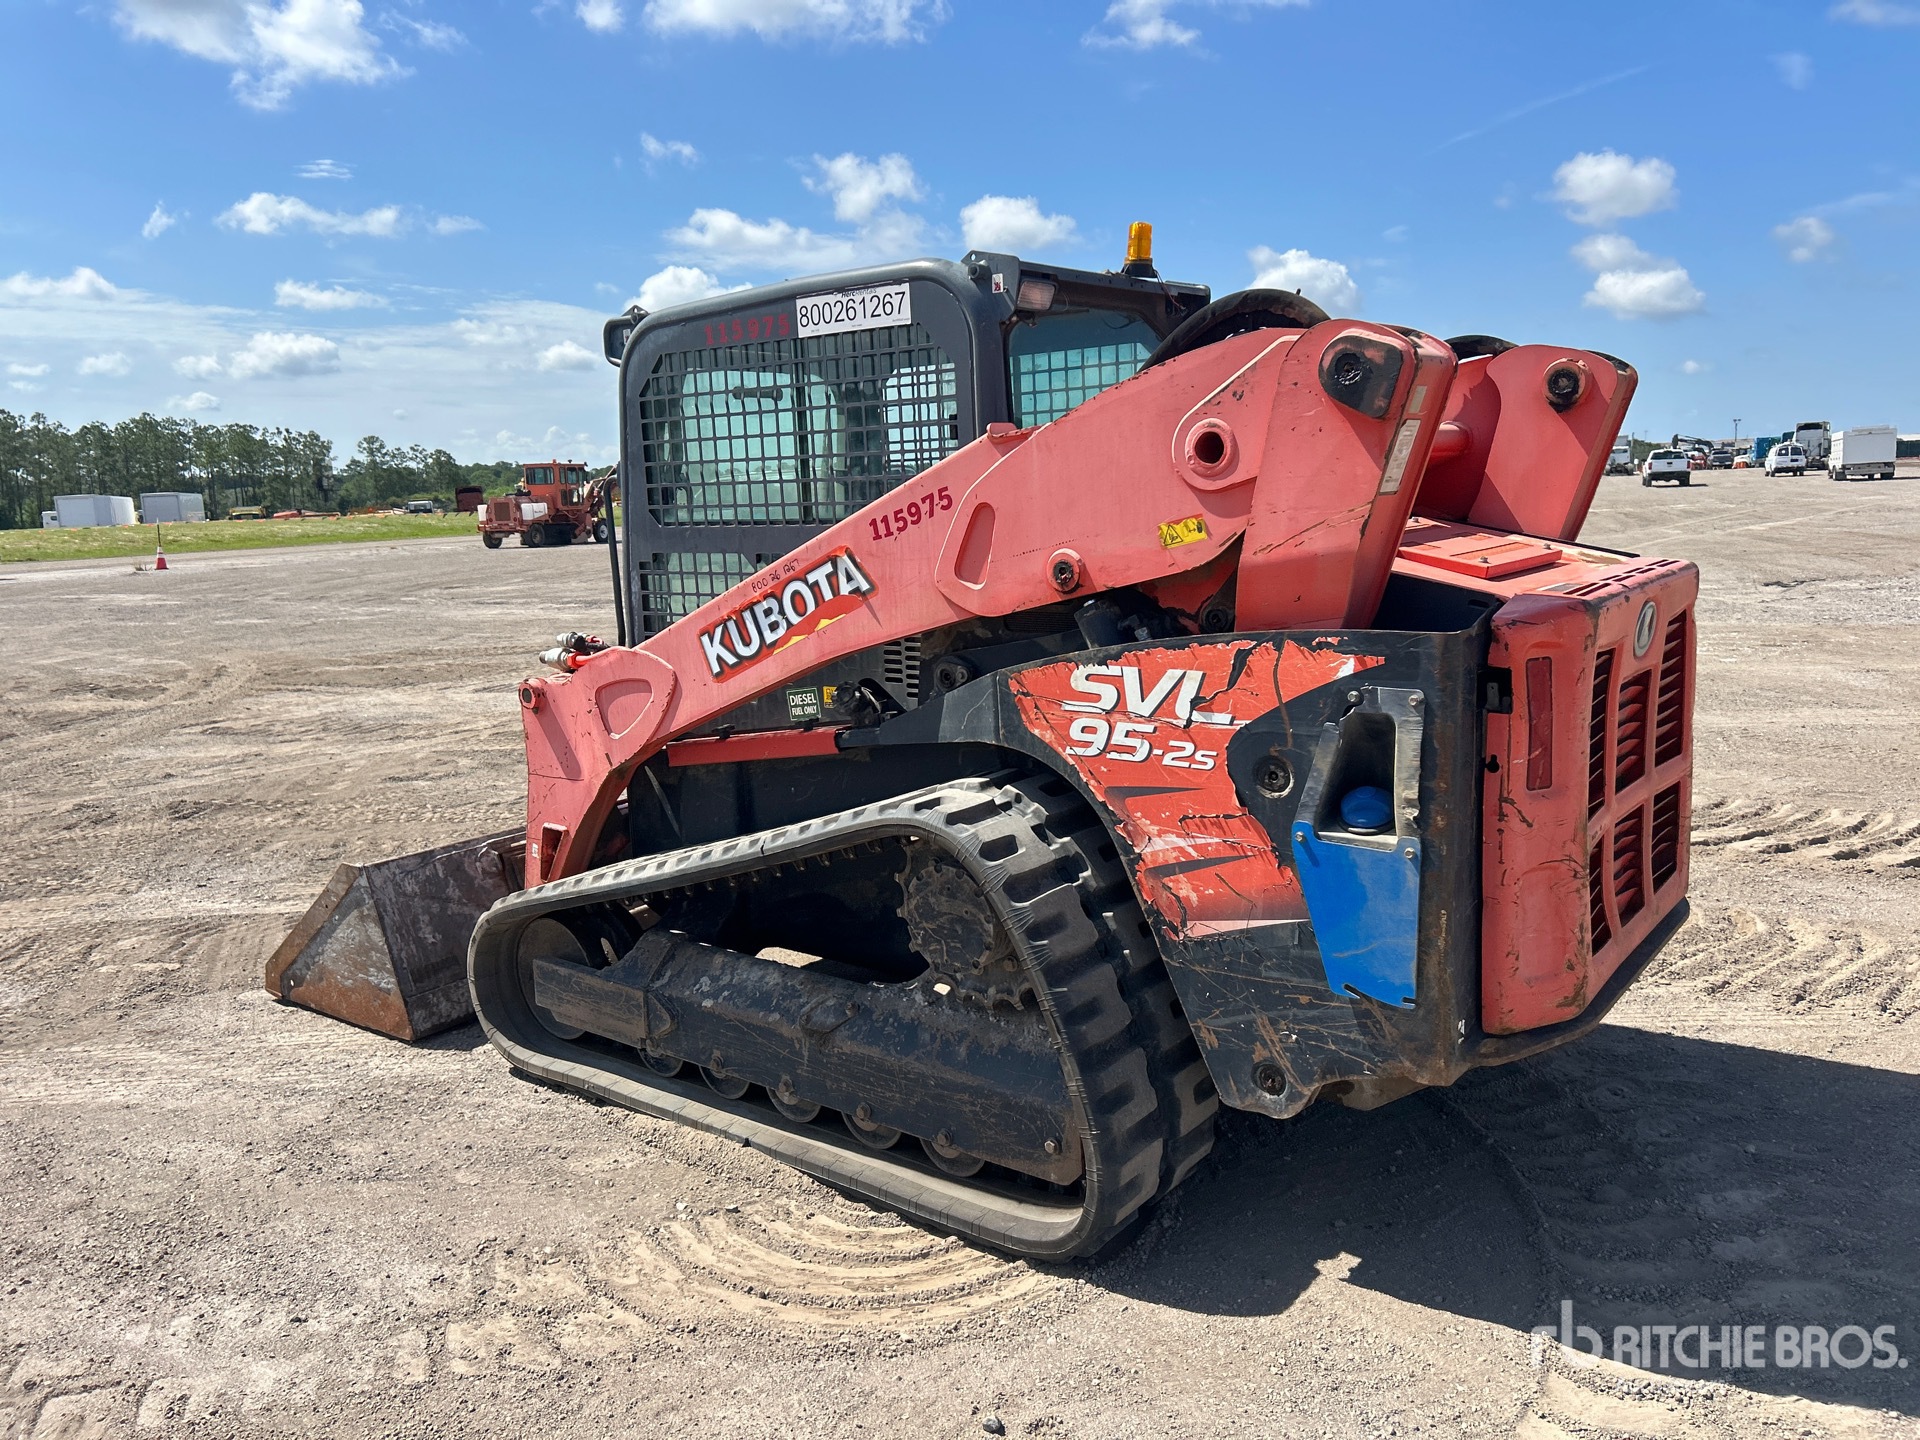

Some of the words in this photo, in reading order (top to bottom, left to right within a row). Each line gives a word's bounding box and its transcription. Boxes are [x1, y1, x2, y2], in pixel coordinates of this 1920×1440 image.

[799, 291, 906, 328] 800261267
[704, 313, 791, 346] 115975
[868, 486, 953, 541] 115975
[751, 577, 769, 593] 800
[699, 553, 871, 676] KUBOTA
[789, 692, 817, 705] DIESEL
[792, 706, 804, 716] FUEL
[804, 705, 817, 714] ONLY
[1060, 664, 1235, 725] SVL
